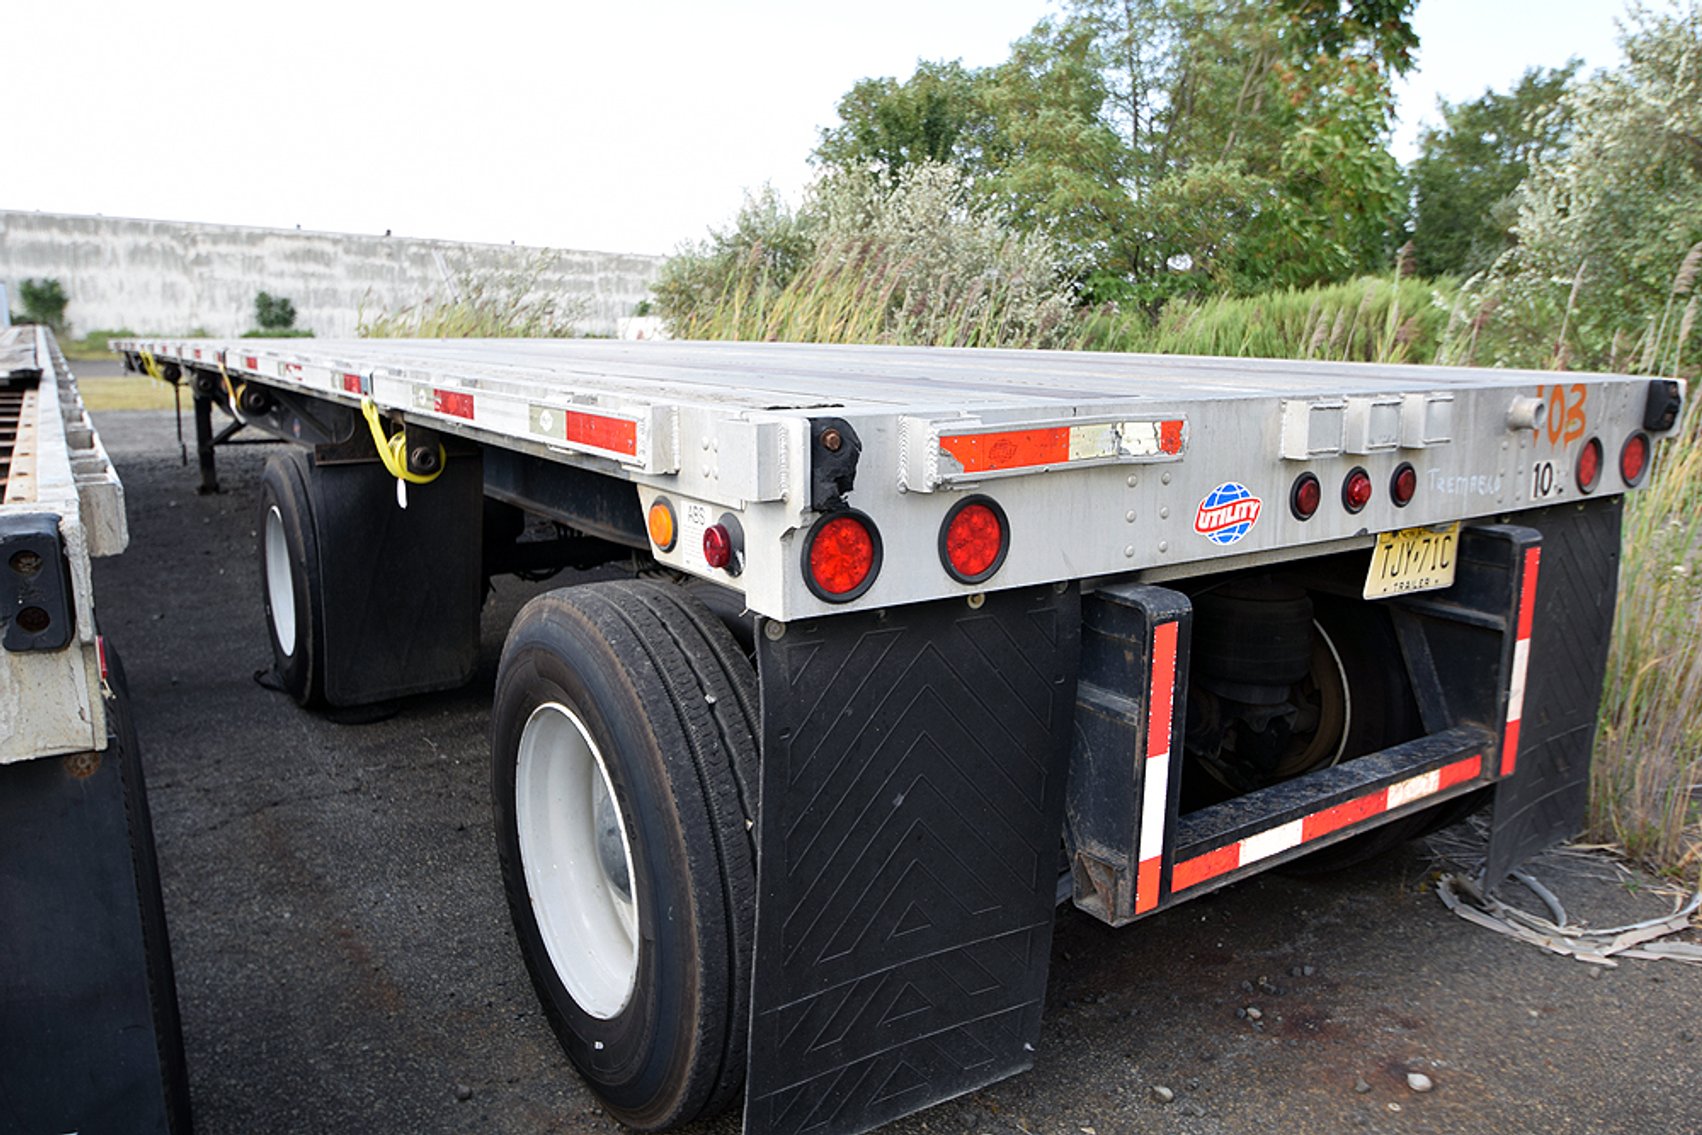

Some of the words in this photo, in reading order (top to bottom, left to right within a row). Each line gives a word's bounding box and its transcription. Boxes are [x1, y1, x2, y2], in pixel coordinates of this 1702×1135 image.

[687, 505, 706, 526] ABS
[1197, 502, 1260, 530] UTILITY
[1393, 577, 1431, 593] TRAILER
